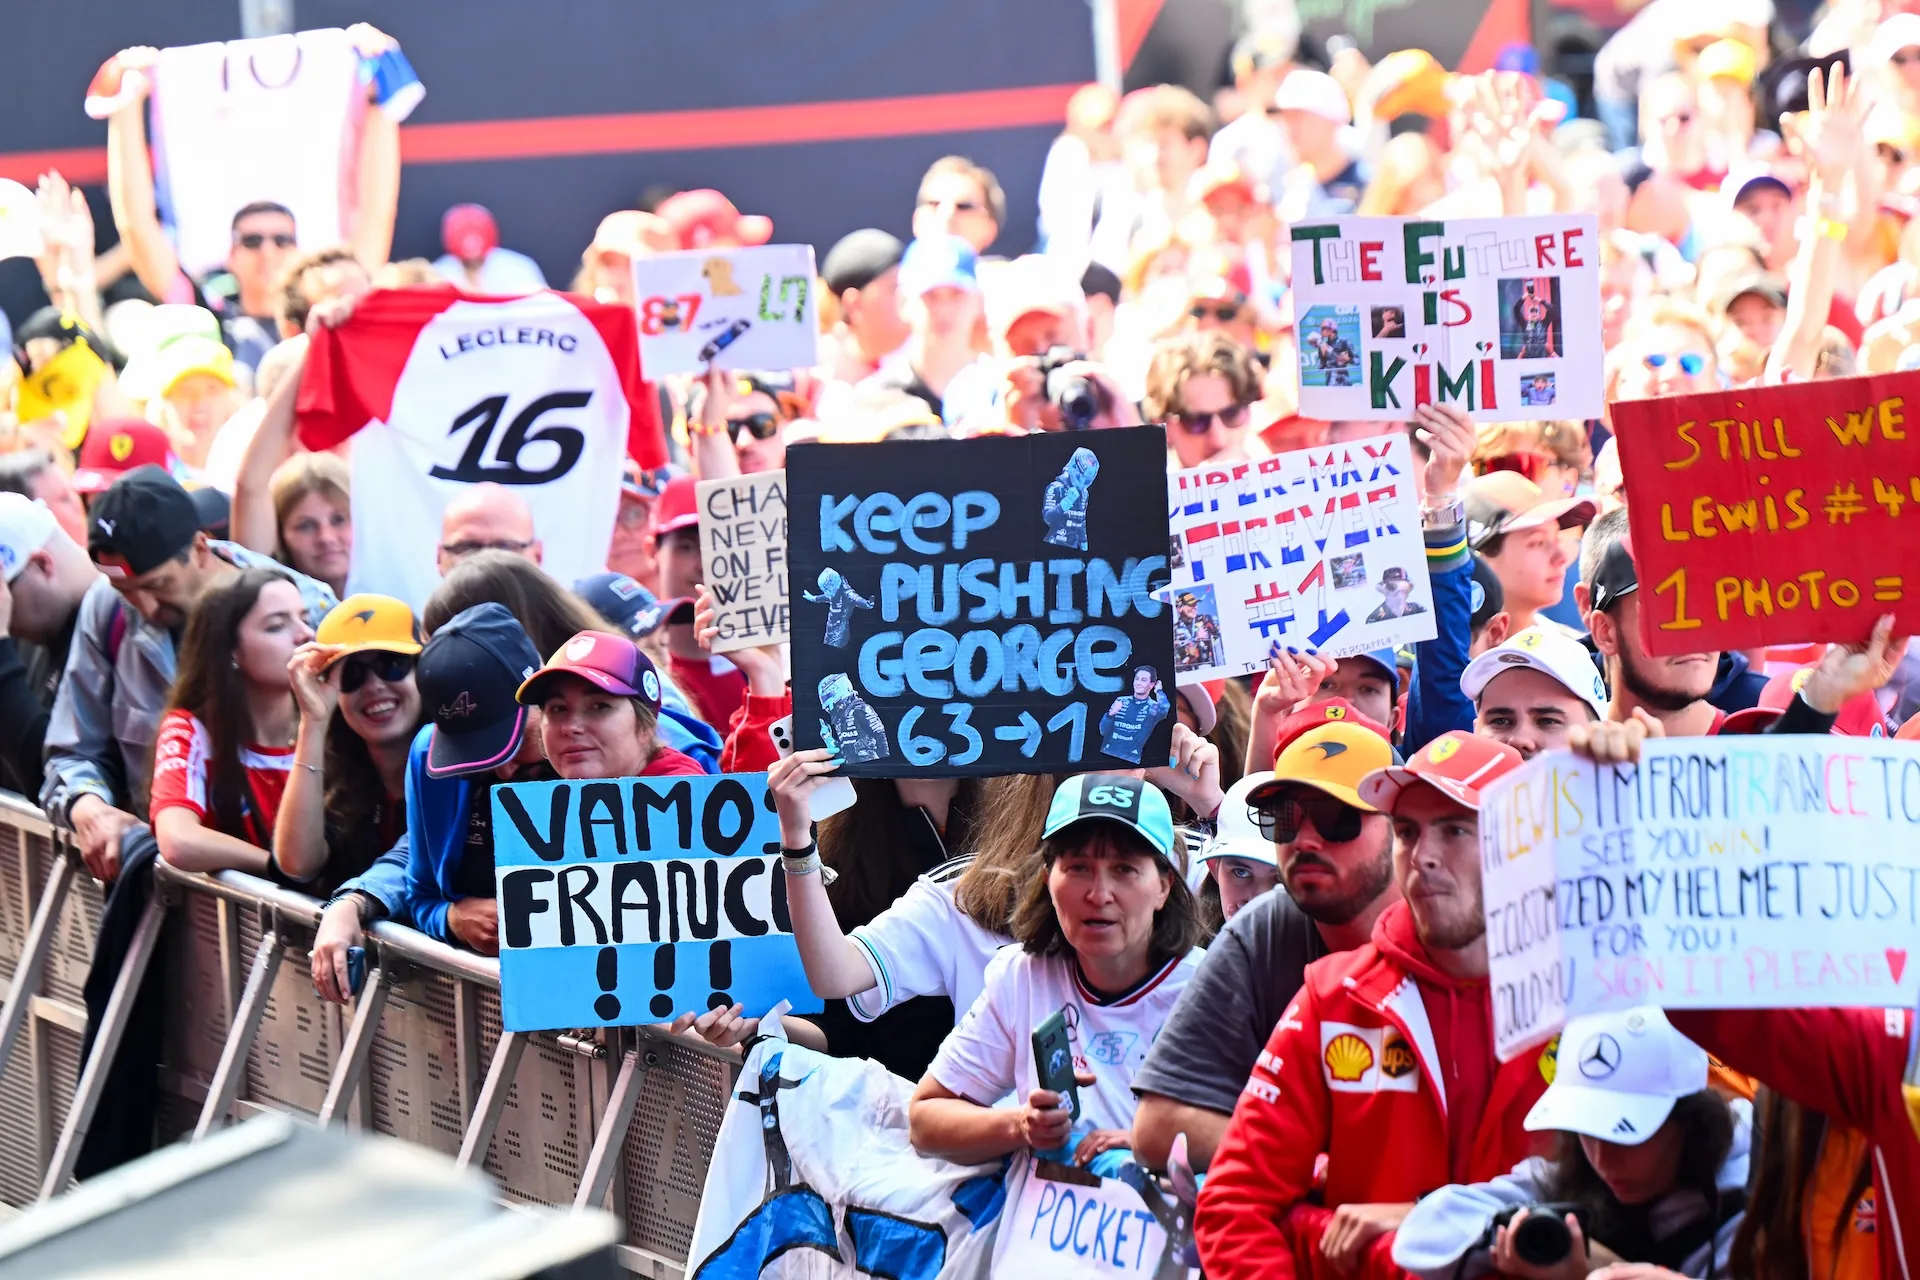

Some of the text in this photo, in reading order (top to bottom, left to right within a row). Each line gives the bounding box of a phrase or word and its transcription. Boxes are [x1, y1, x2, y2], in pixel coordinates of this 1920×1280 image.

[1291, 219, 1584, 285] THE FUTURE
[439, 326, 578, 361] LECLERC
[428, 389, 594, 485] 16
[1825, 397, 1907, 447] WE
[711, 549, 750, 579] ON
[1185, 484, 1400, 583] FOREVER
[881, 554, 1171, 626] PUSHING
[1654, 566, 1703, 631] 1
[1714, 569, 1860, 622] PHOTO
[898, 701, 1088, 767] 63 1
[1088, 786, 1135, 809] 63
[1506, 767, 1584, 860] LEWIS
[1649, 755, 1729, 821] FROM
[1731, 749, 1869, 818] FRANCE
[1581, 828, 1636, 872] SEE
[1648, 827, 1700, 861] YOU
[1624, 866, 1666, 919] MY
[1673, 860, 1810, 919] HELMET
[1820, 861, 1920, 925] JUST
[1592, 922, 1738, 960] FOR YOU!
[1593, 953, 1666, 1003] SIGN
[1680, 954, 1729, 998] IT
[1741, 945, 1884, 995] PLEASE
[1030, 1182, 1157, 1272] POCKET
